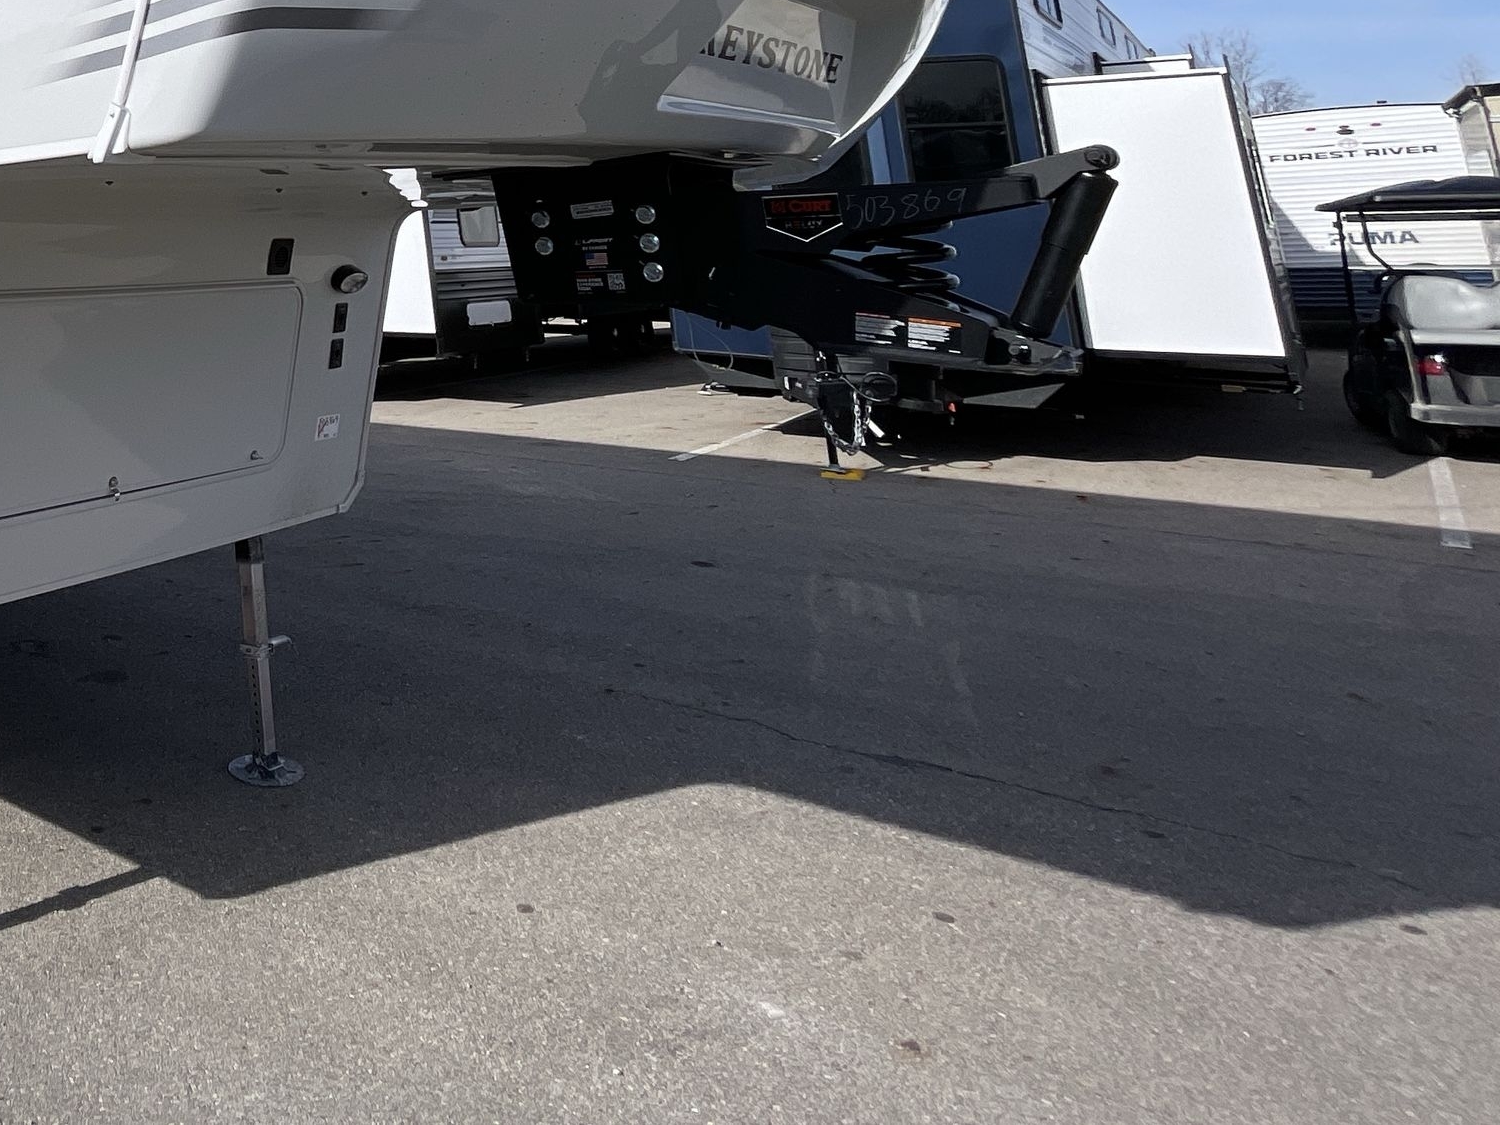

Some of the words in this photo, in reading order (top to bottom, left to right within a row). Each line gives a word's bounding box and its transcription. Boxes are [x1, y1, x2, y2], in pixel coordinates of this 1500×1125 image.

[1269, 150, 1358, 163] FOREST
[1365, 144, 1438, 156] RIVER
[845, 187, 968, 230] 503869
